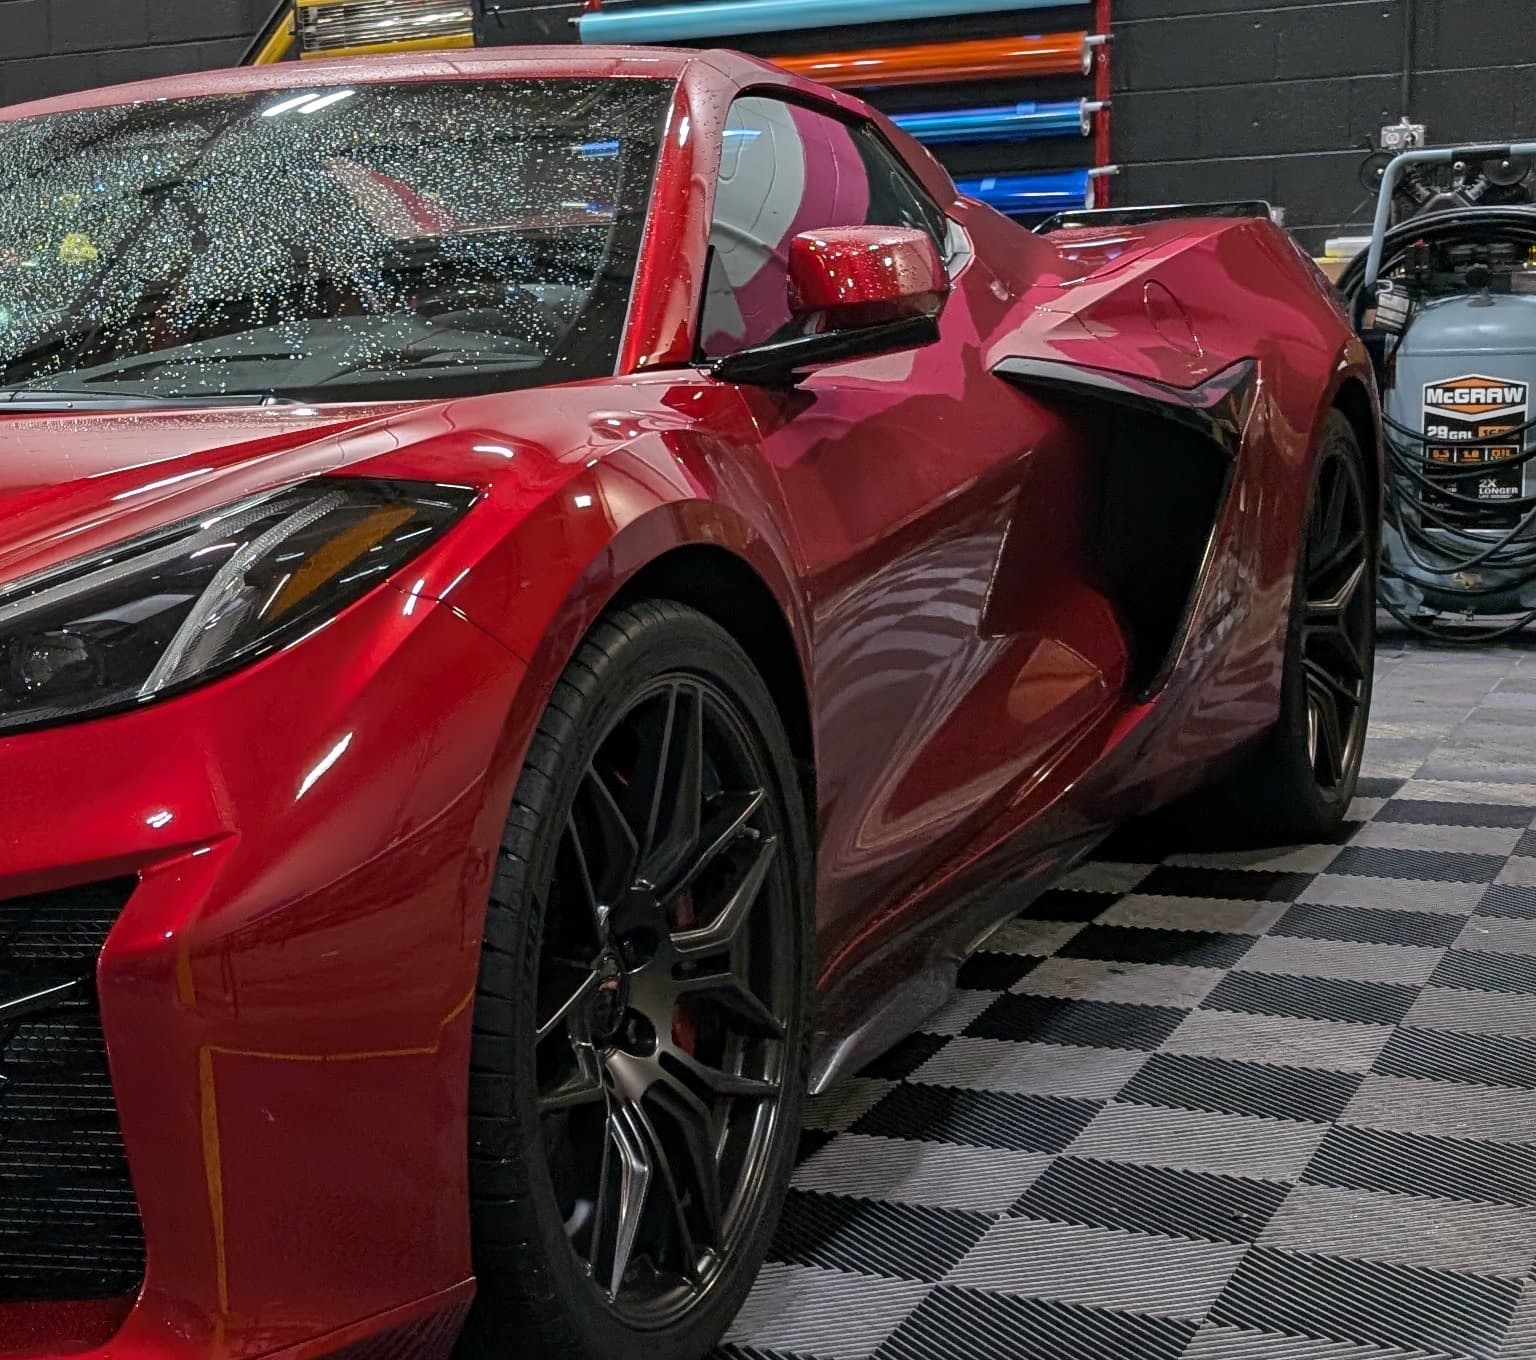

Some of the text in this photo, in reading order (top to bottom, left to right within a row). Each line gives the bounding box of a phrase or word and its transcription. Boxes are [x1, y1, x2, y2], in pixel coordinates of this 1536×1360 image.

[1426, 387, 1524, 404] McGRAW
[1427, 426, 1449, 439] 29
[1479, 487, 1519, 495] LONGER
